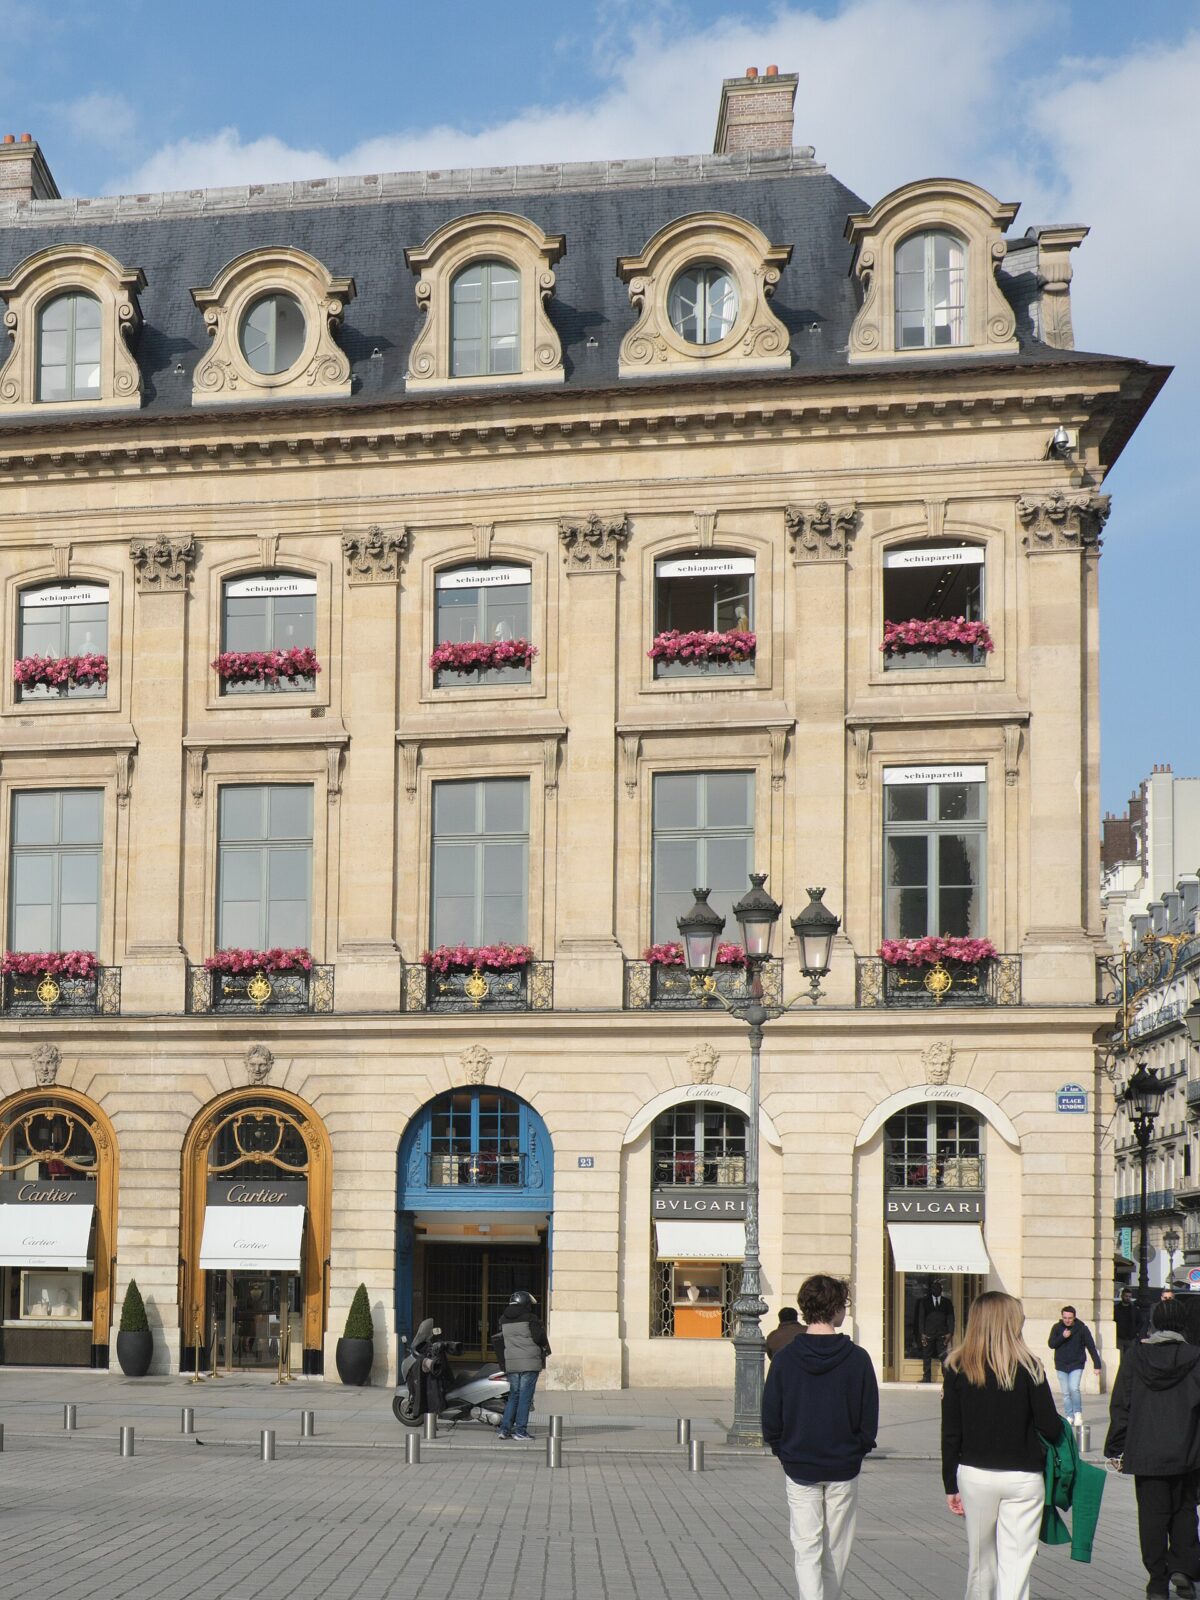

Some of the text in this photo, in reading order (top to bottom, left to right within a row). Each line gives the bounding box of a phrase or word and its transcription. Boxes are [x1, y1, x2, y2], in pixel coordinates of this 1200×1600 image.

[904, 553, 963, 563] schiaparelli
[677, 564, 734, 573] schiaparelli
[456, 574, 510, 584] schiaparelli
[245, 585, 298, 593] schiaparelli
[39, 593, 91, 602] schiaparelli
[904, 771, 963, 780] schiaparelli
[686, 1086, 720, 1097] Cartier
[924, 1085, 961, 1098] Cartier
[580, 1158, 592, 1167] 23
[18, 1183, 77, 1202] Cartier
[227, 1184, 287, 1203] Cartier
[656, 1200, 744, 1210] BVLGARI
[888, 1202, 980, 1213] BVLGARI
[22, 1236, 58, 1246] Cartier
[233, 1239, 269, 1249] Cartier
[916, 1264, 969, 1272] BVLGARI
